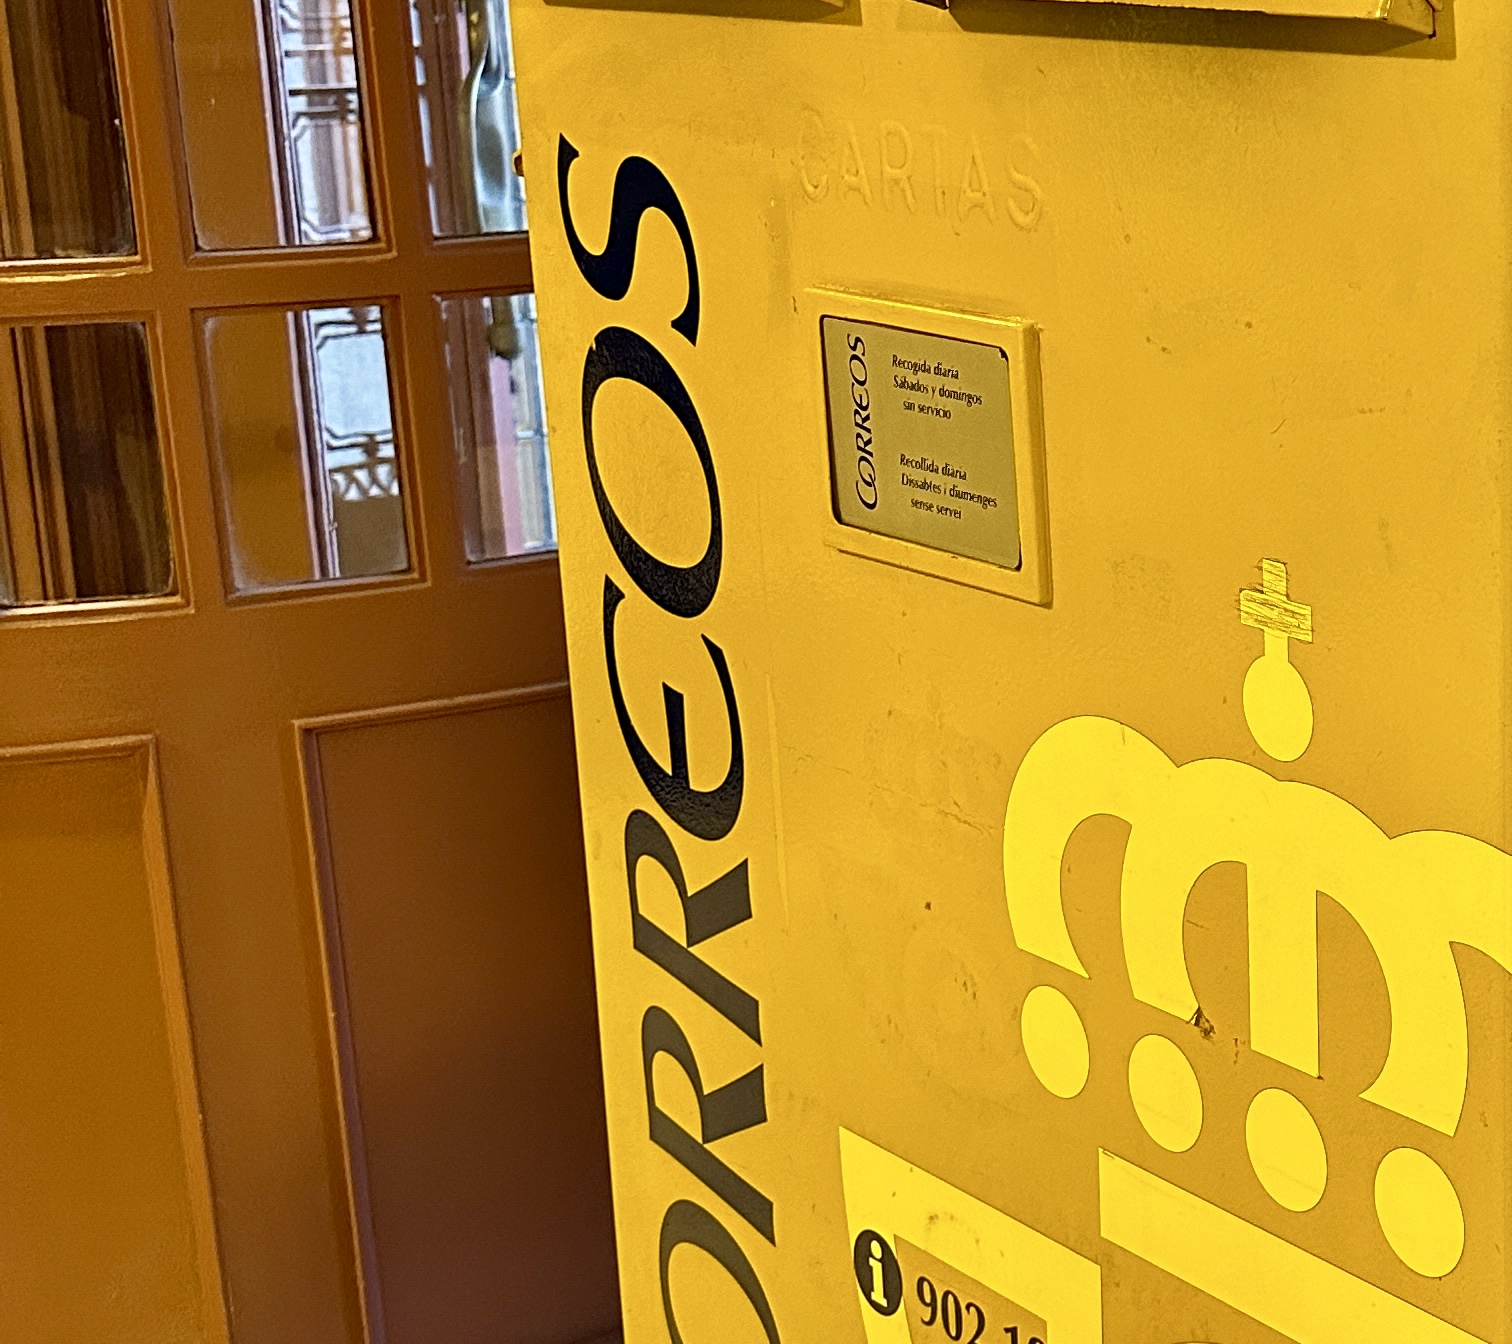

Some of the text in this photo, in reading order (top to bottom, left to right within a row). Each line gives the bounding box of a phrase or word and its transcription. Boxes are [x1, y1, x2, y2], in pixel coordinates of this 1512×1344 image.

[800, 105, 1044, 233] CARTAS
[892, 354, 959, 380] Recogida diaria
[931, 386, 937, 400] y
[938, 383, 983, 408] domingos
[903, 397, 952, 420] sin servicio
[846, 332, 878, 511] CORREOS
[899, 453, 939, 475] Recollida
[901, 472, 942, 495] Dissables
[949, 483, 998, 510] diumenges
[910, 497, 962, 520] sense servei
